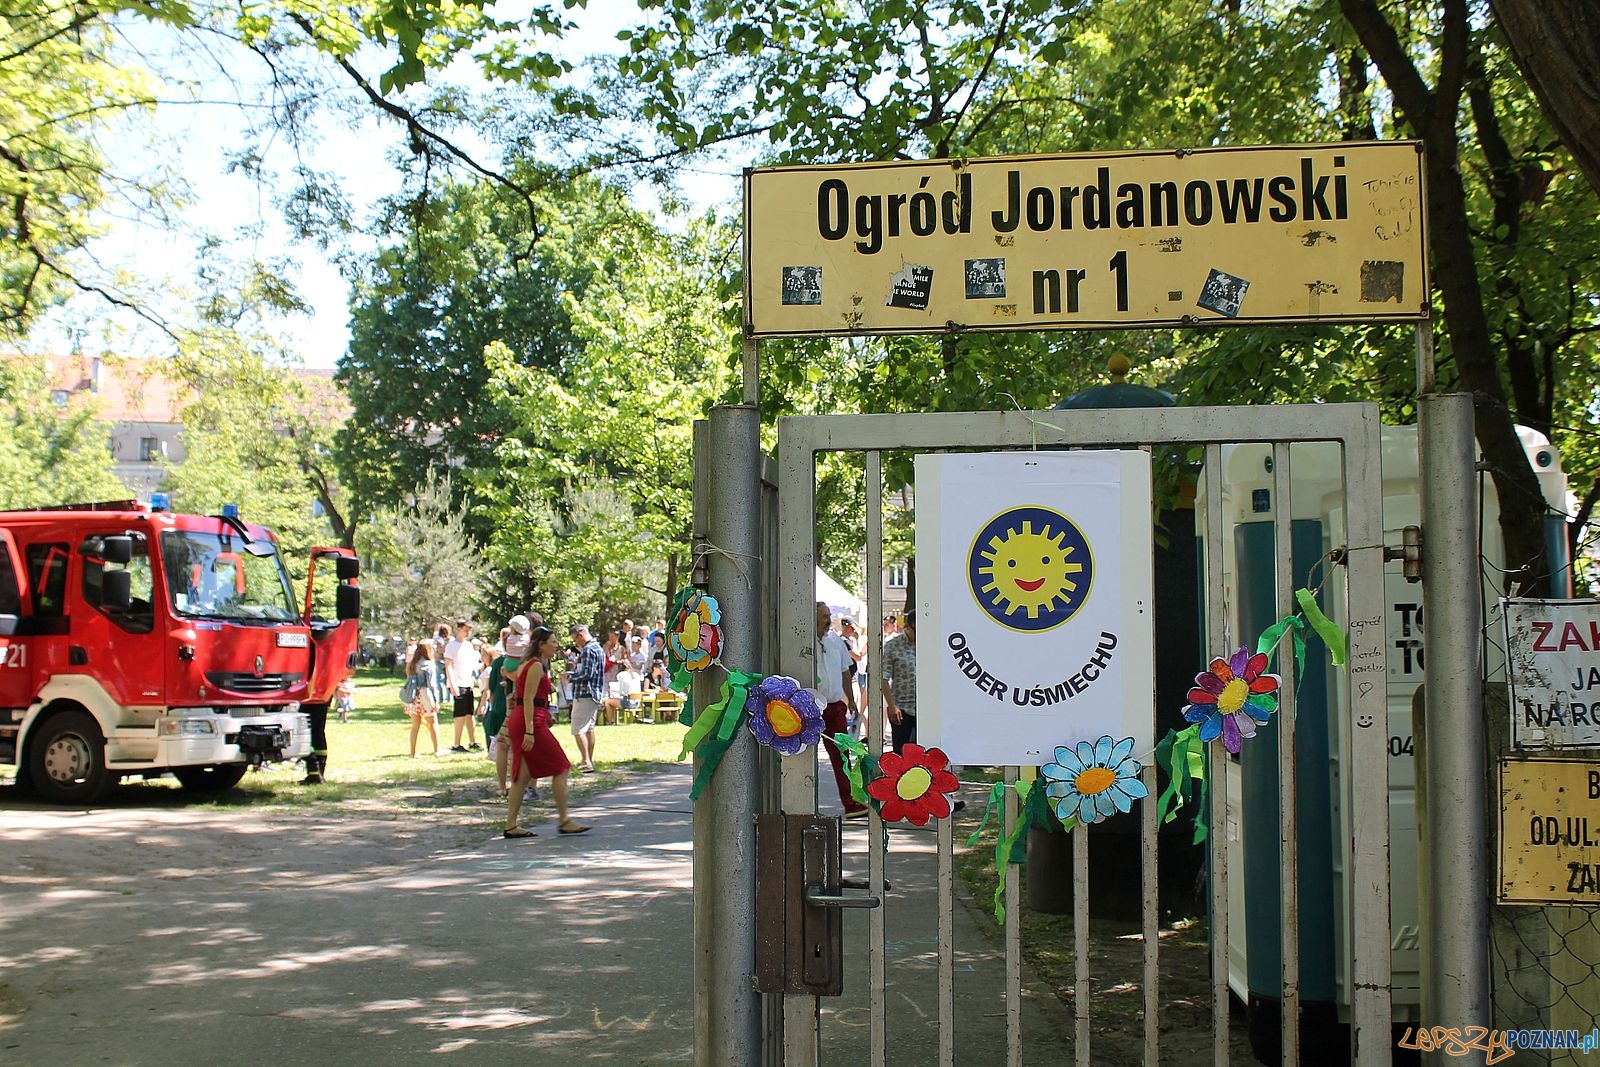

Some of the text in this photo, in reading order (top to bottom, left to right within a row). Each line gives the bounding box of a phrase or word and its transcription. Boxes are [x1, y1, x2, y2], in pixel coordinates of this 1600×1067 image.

[817, 155, 1348, 255] Ogród Jordanowski
[900, 290, 925, 298] WORLD
[911, 274, 929, 282] MILE
[1032, 250, 1129, 314] nr 1
[947, 631, 1118, 707] ORDER UŚMIECHU
[1530, 816, 1599, 847] OD UL.
